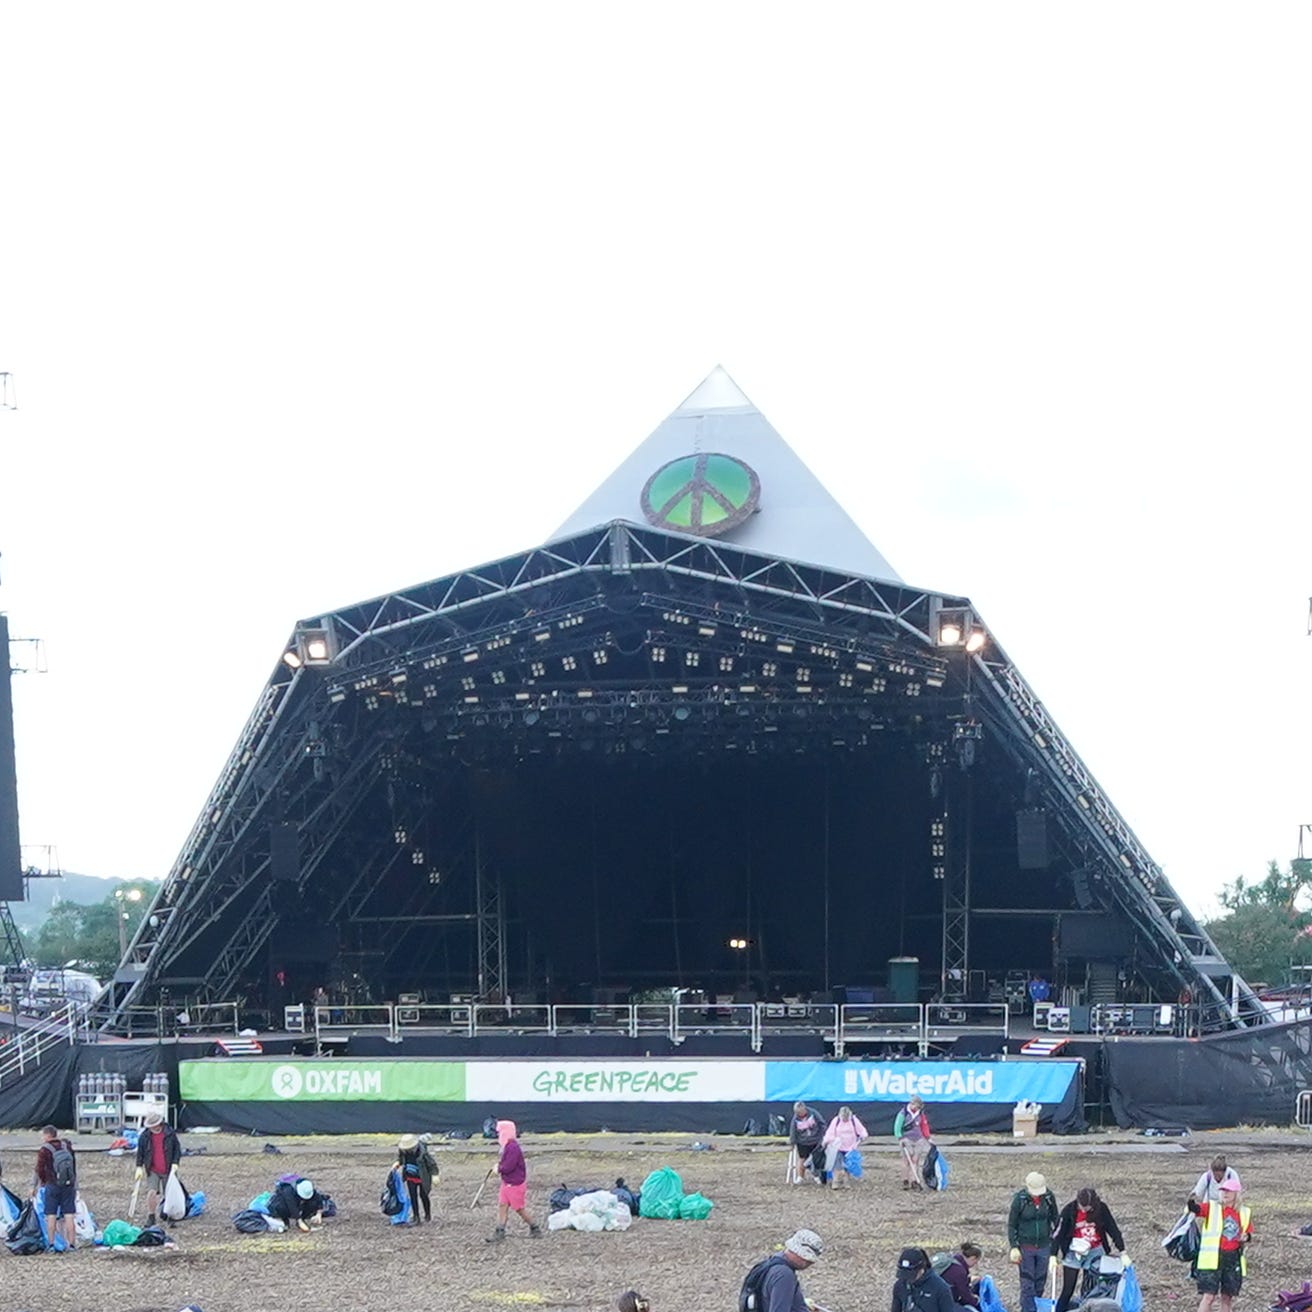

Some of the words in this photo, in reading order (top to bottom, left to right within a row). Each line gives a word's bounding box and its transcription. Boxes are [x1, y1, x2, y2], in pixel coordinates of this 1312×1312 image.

[305, 1070, 381, 1093] OXFAM
[533, 1071, 698, 1096] GREENPEACE
[859, 1069, 993, 1095] WaterAid
